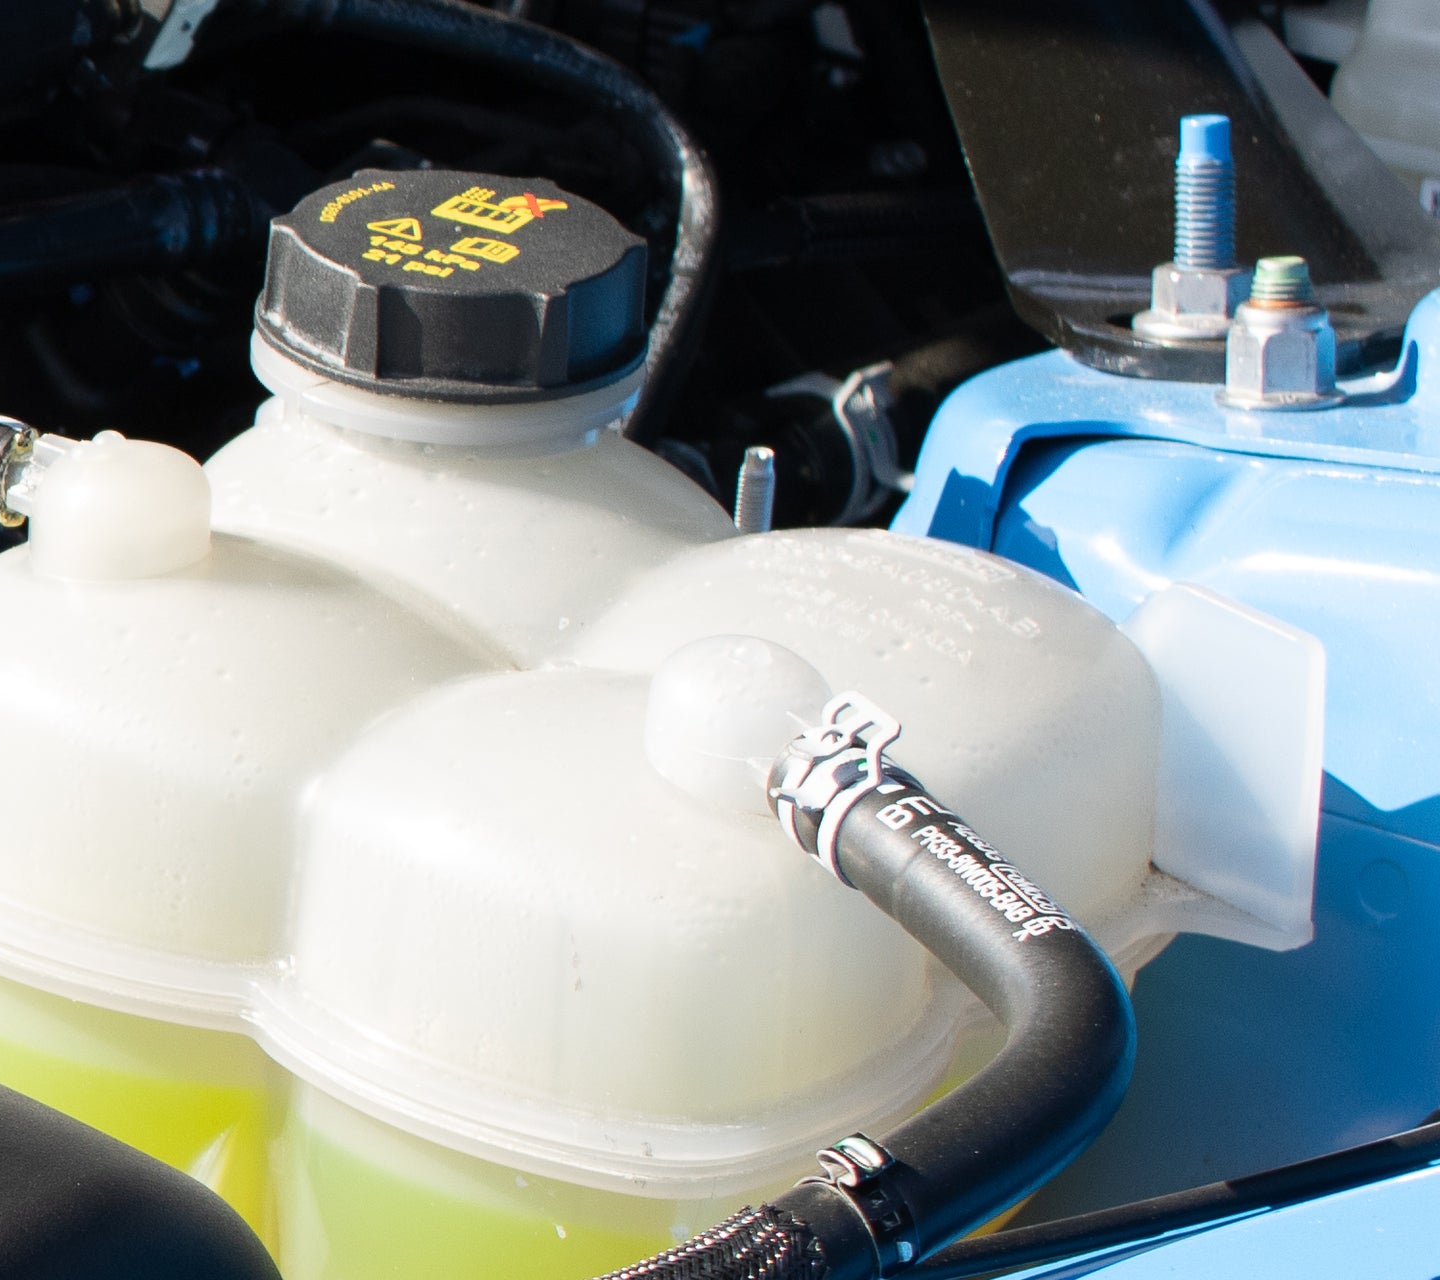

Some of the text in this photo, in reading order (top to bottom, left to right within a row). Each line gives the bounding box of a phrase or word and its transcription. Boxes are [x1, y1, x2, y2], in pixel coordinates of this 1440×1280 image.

[361, 248, 455, 279] 21 psi
[368, 234, 481, 272] 145 kPa
